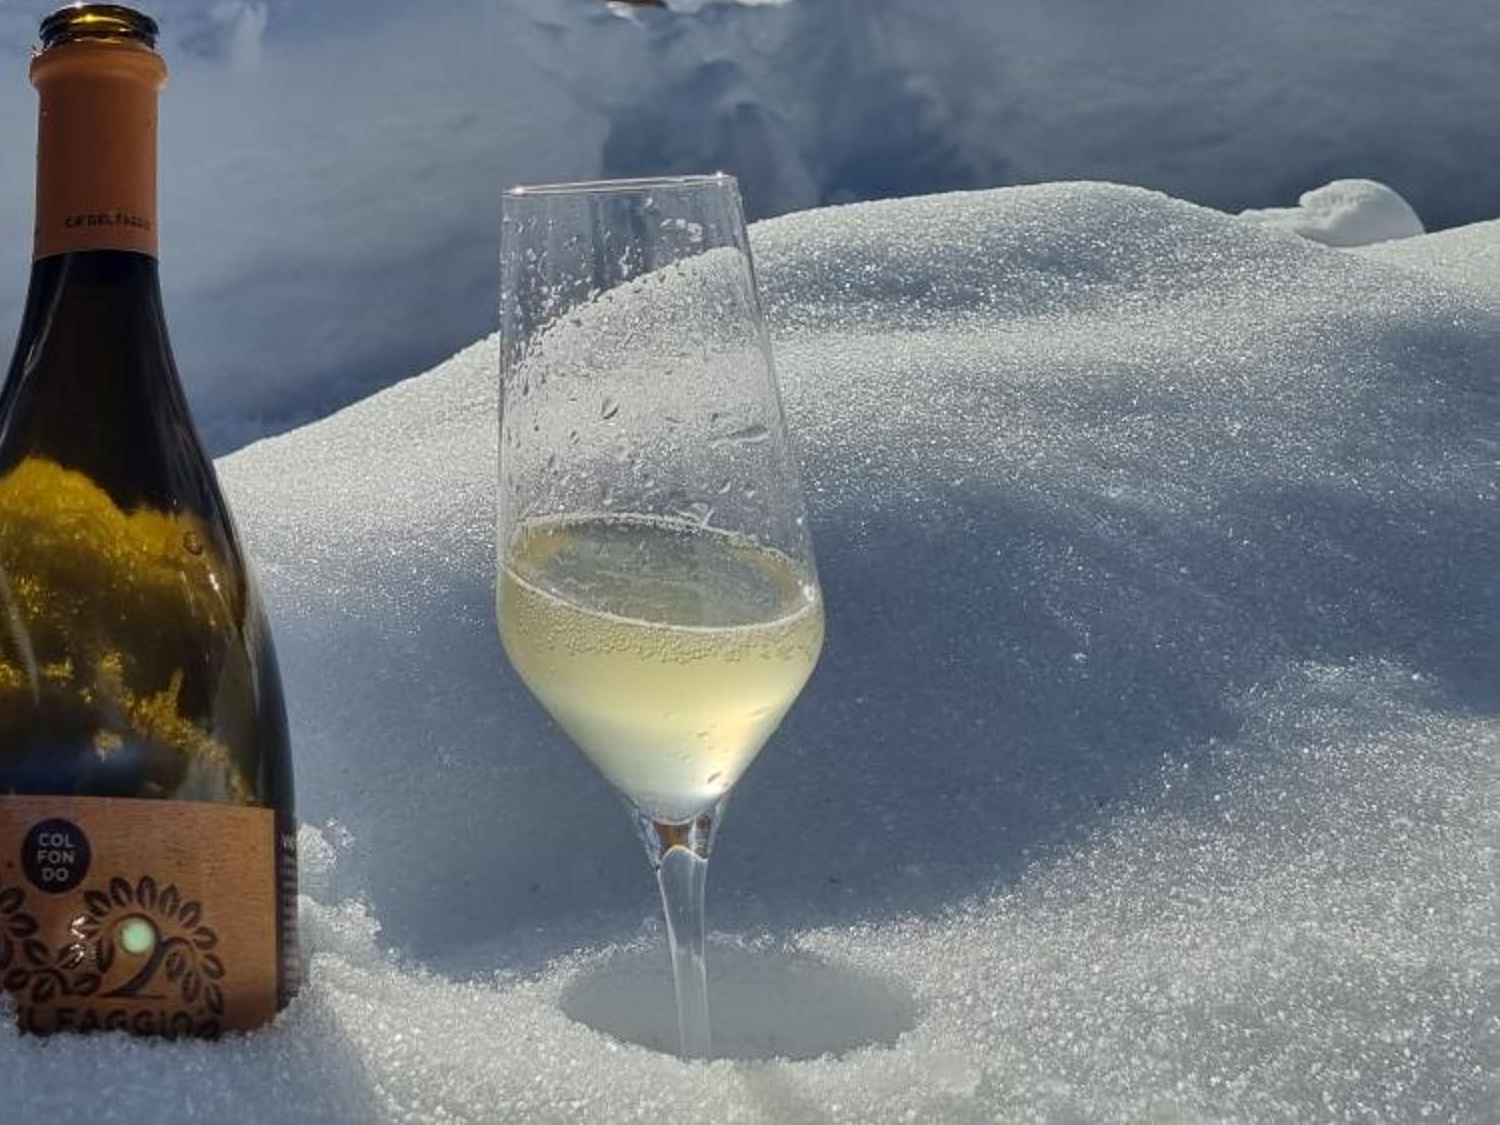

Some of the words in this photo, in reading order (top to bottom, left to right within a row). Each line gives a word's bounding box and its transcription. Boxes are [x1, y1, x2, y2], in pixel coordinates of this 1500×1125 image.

[39, 832, 74, 848] COL
[37, 849, 75, 864] FON
[42, 867, 69, 882] DO
